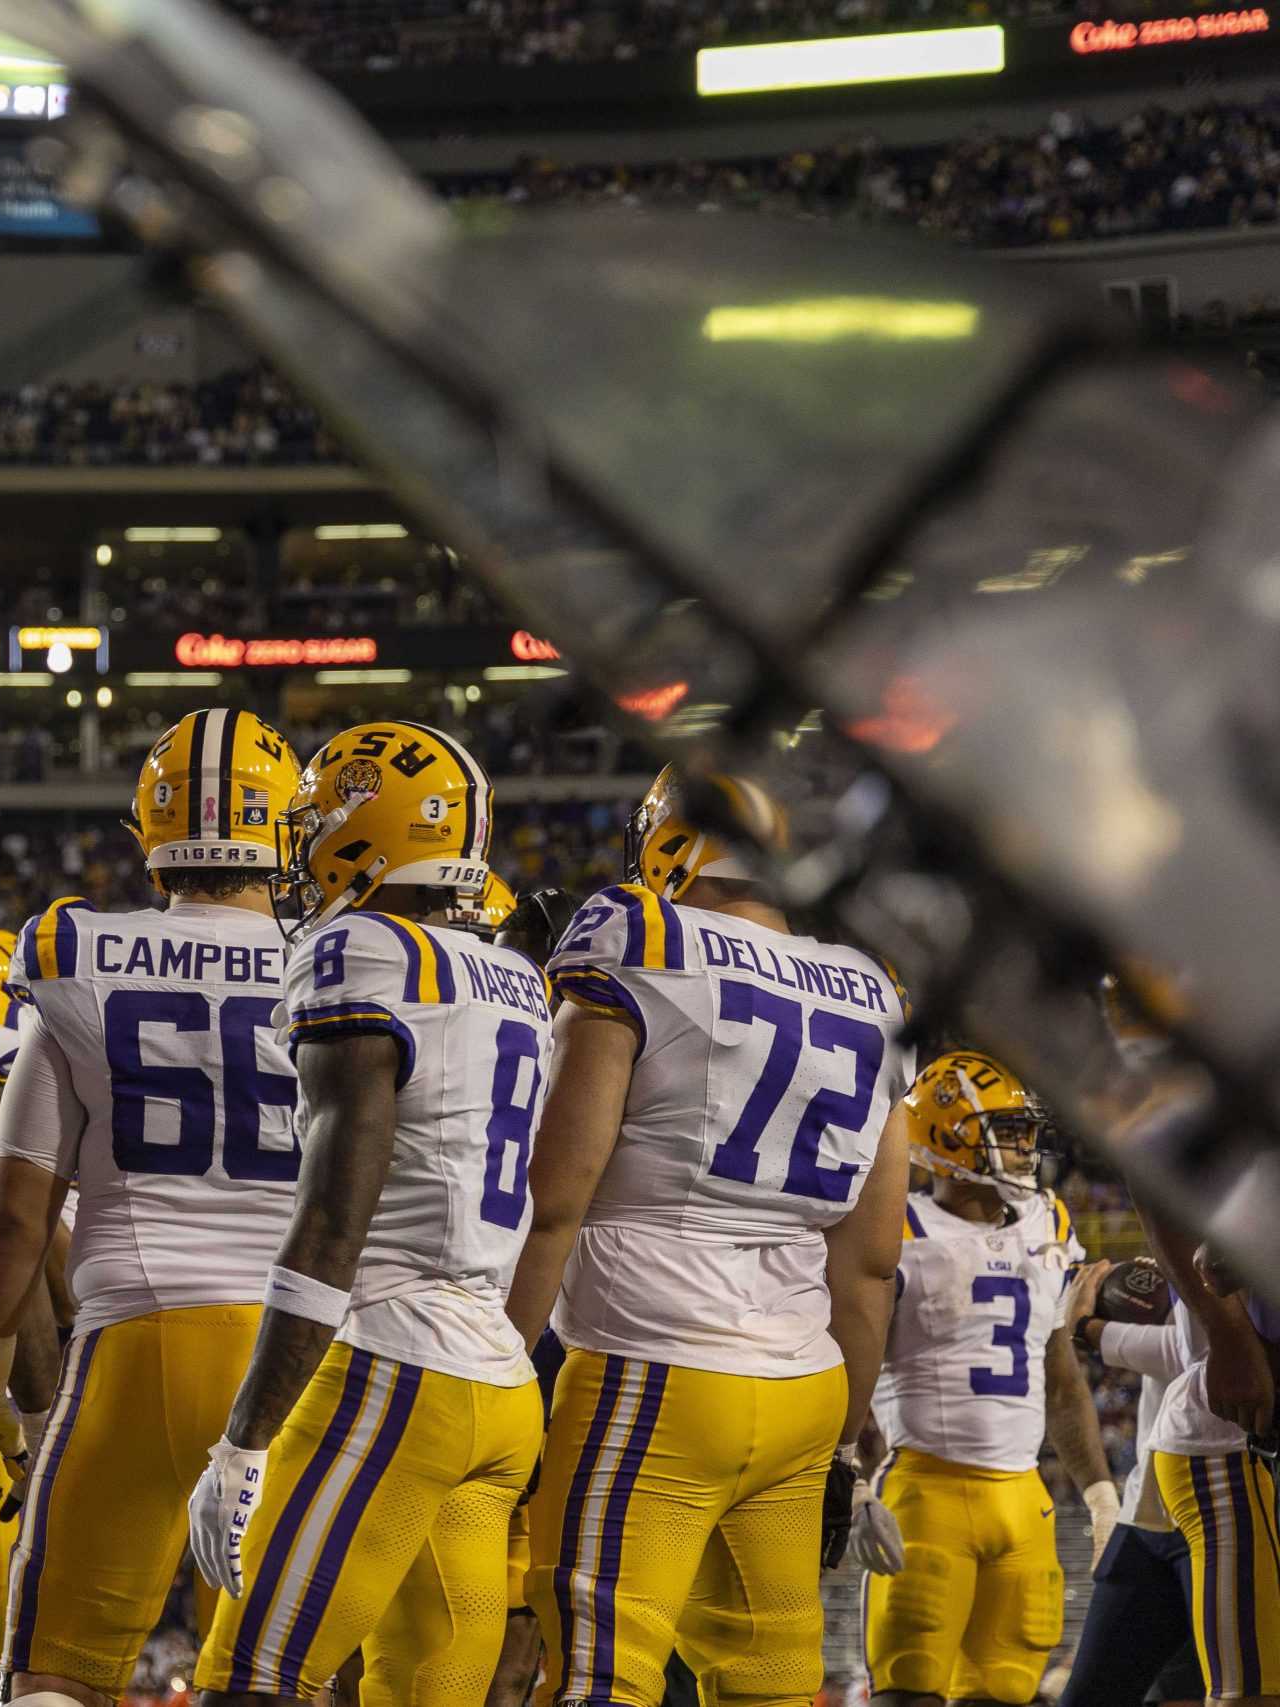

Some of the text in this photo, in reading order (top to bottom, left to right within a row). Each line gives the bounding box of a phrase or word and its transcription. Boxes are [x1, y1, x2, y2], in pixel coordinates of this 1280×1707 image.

[429, 799, 440, 818] 3
[169, 848, 257, 861] TIGERS
[440, 866, 488, 883] TIGE
[97, 933, 287, 985] CAMPBE
[313, 929, 350, 990] 8
[459, 951, 548, 1022] NABERS
[699, 927, 887, 1013] DELLINGER
[104, 990, 301, 1182] 66
[708, 978, 885, 1202] 72
[480, 1018, 541, 1230] 8
[987, 1261, 1011, 1271] LSU
[970, 1276, 1031, 1397] 3
[228, 1466, 259, 1582] TIGERS
